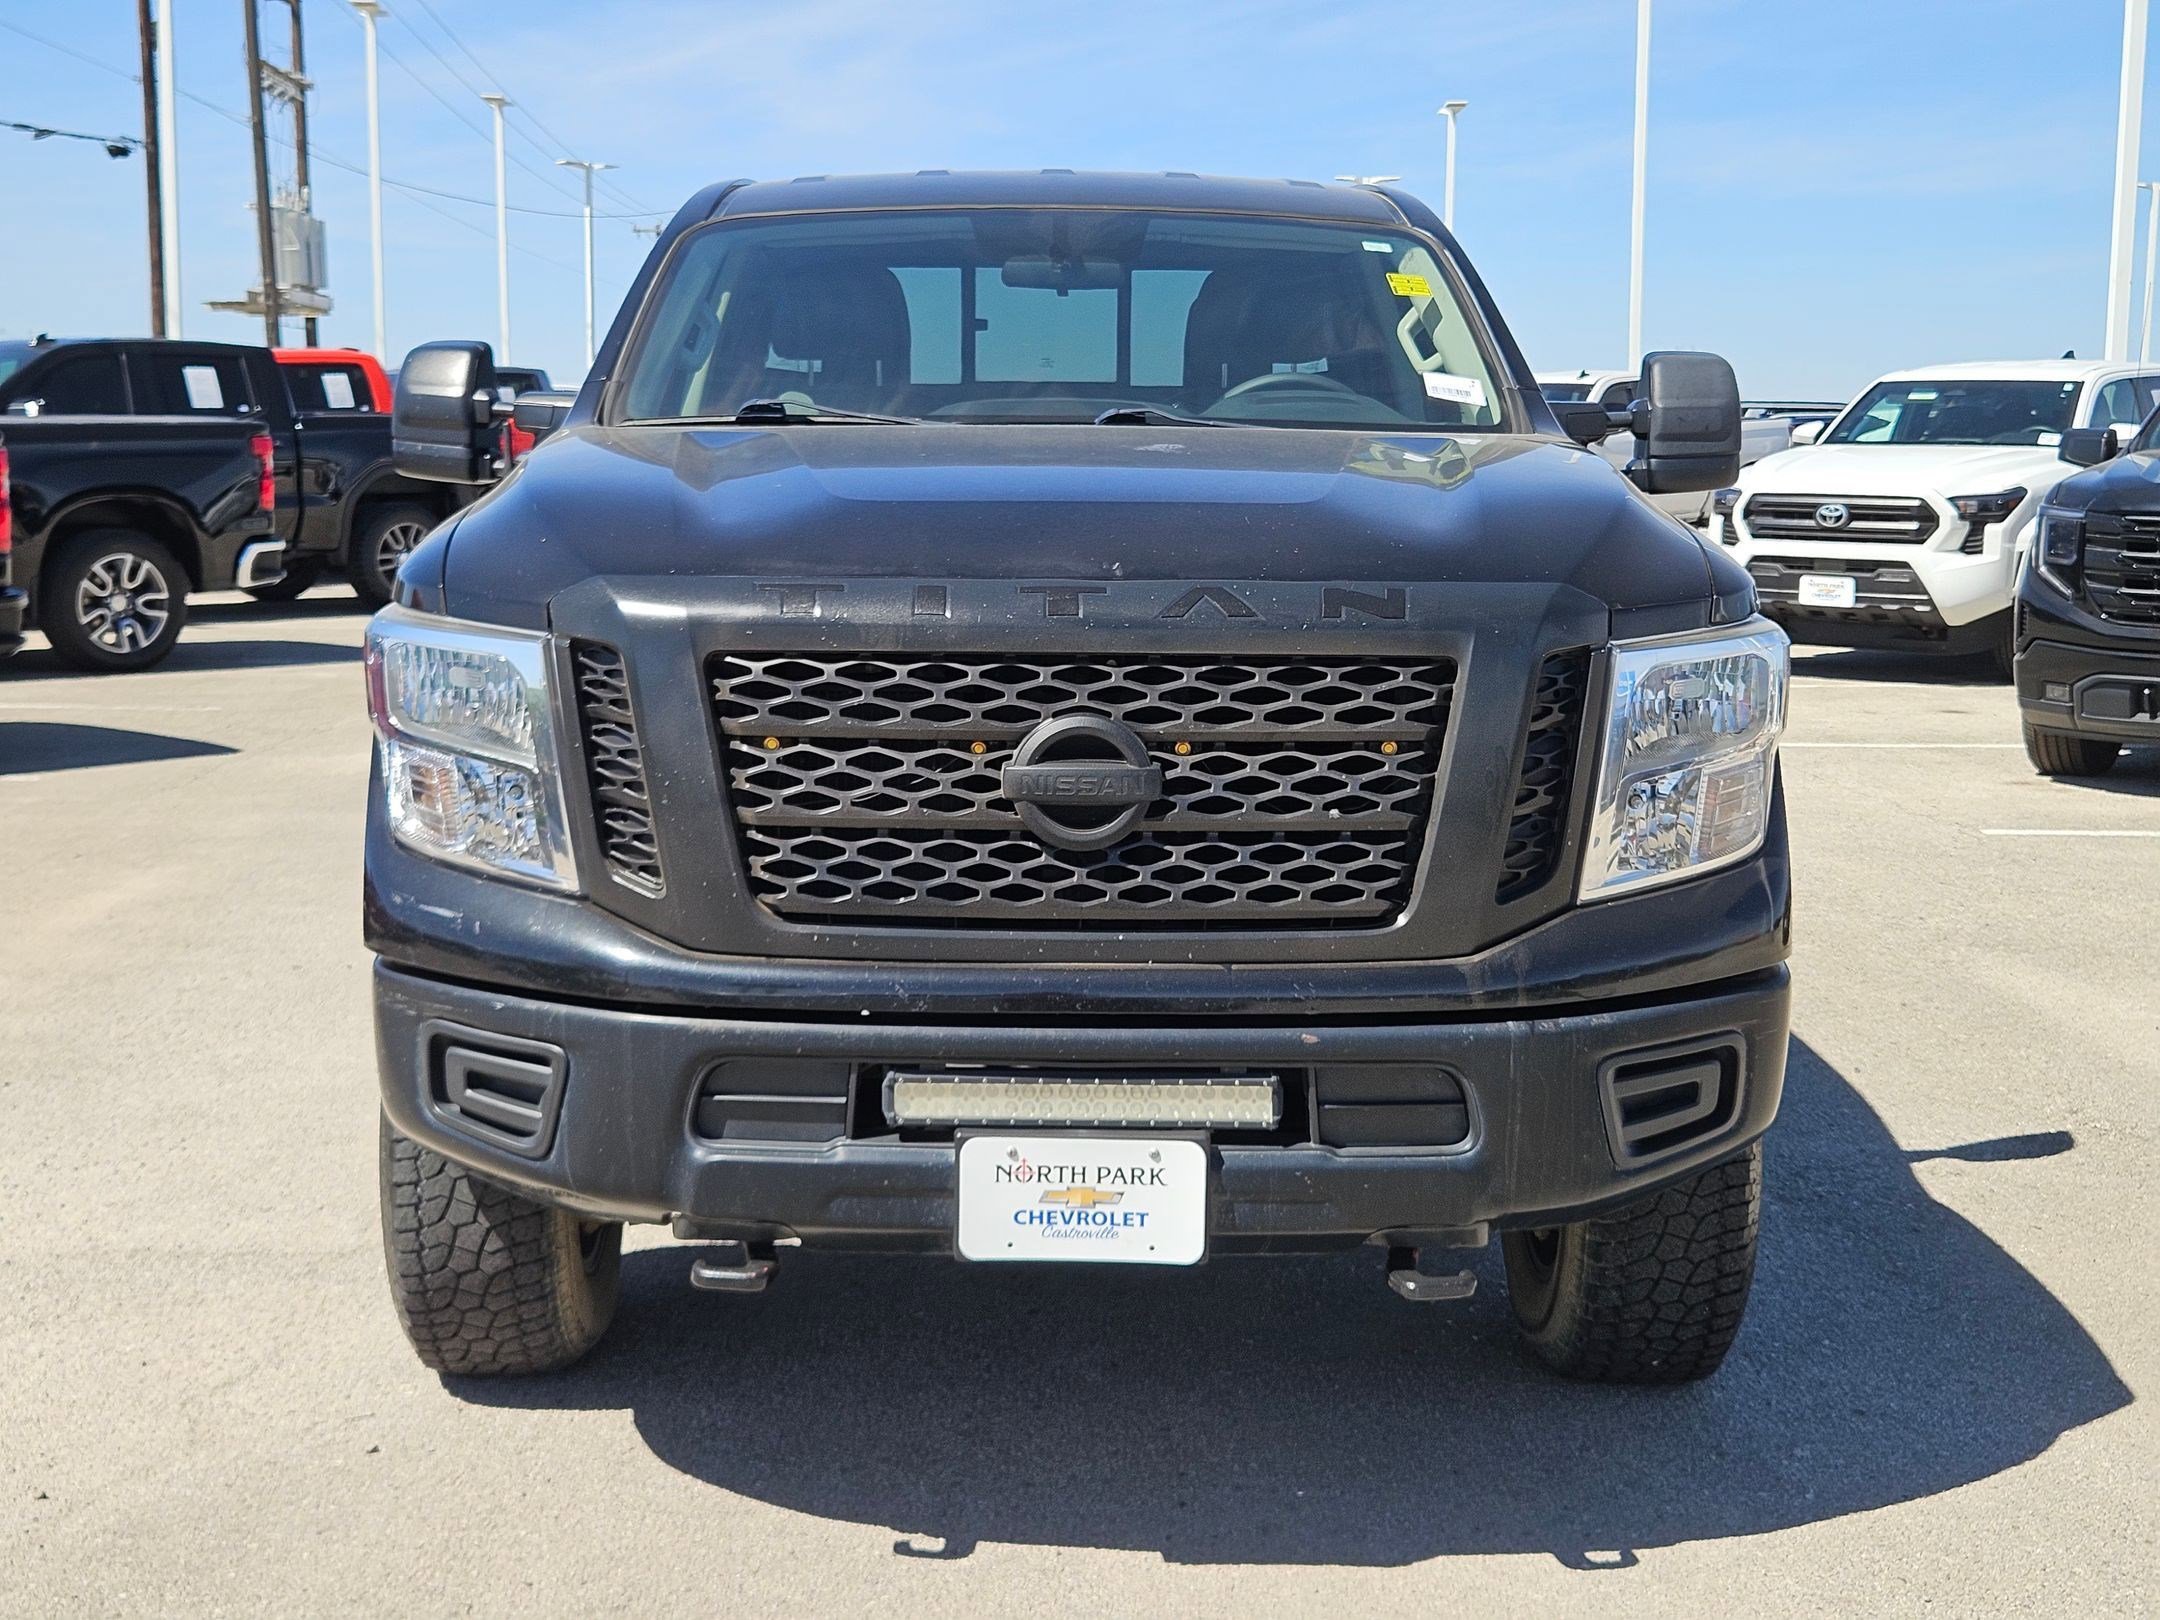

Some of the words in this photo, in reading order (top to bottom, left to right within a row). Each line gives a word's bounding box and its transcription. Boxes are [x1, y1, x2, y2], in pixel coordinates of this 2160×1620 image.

[753, 583, 1406, 618] TITAN
[1020, 771, 1147, 797] NISSAN
[995, 1163, 1086, 1184] NORTH
[1097, 1166, 1168, 1187] PARK
[1014, 1208, 1149, 1228] CHEVROLET
[1041, 1223, 1120, 1240] Castroville
